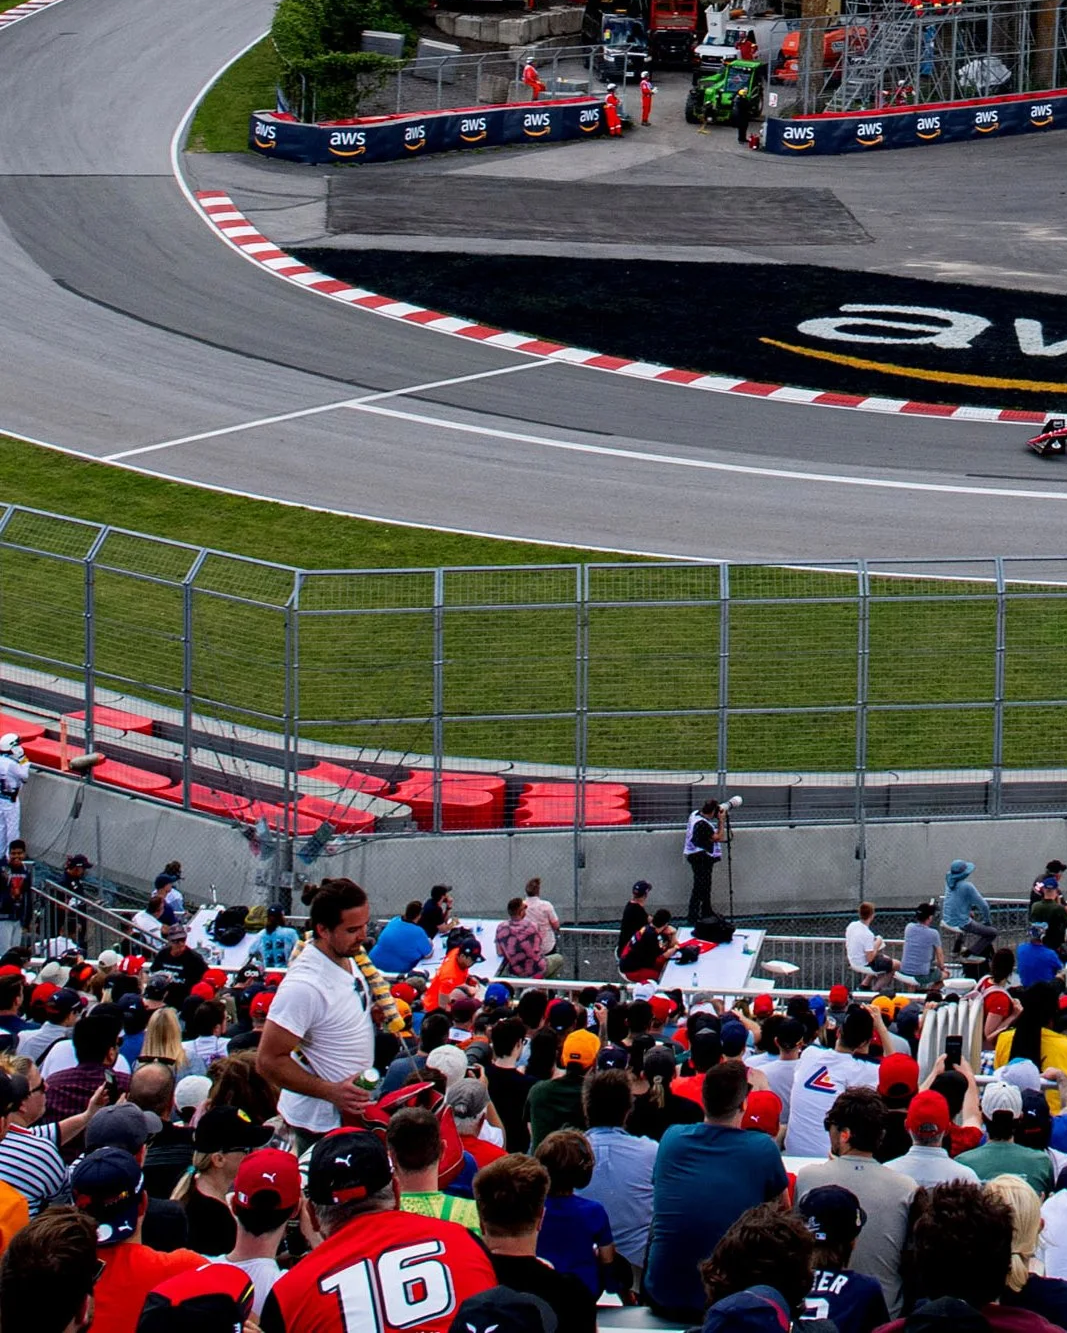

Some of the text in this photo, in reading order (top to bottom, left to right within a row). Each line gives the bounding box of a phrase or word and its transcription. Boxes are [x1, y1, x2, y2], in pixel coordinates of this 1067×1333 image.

[580, 109, 599, 122] aws
[975, 111, 998, 123] aws
[1031, 104, 1052, 117] aws
[461, 118, 486, 132] aws
[524, 113, 550, 126] aws
[917, 117, 940, 130] aws
[255, 121, 276, 139] aws
[405, 125, 425, 140] aws
[783, 127, 814, 139] aws
[857, 123, 882, 136] aws
[330, 132, 365, 145] aws
[319, 1238, 457, 1333] 16
